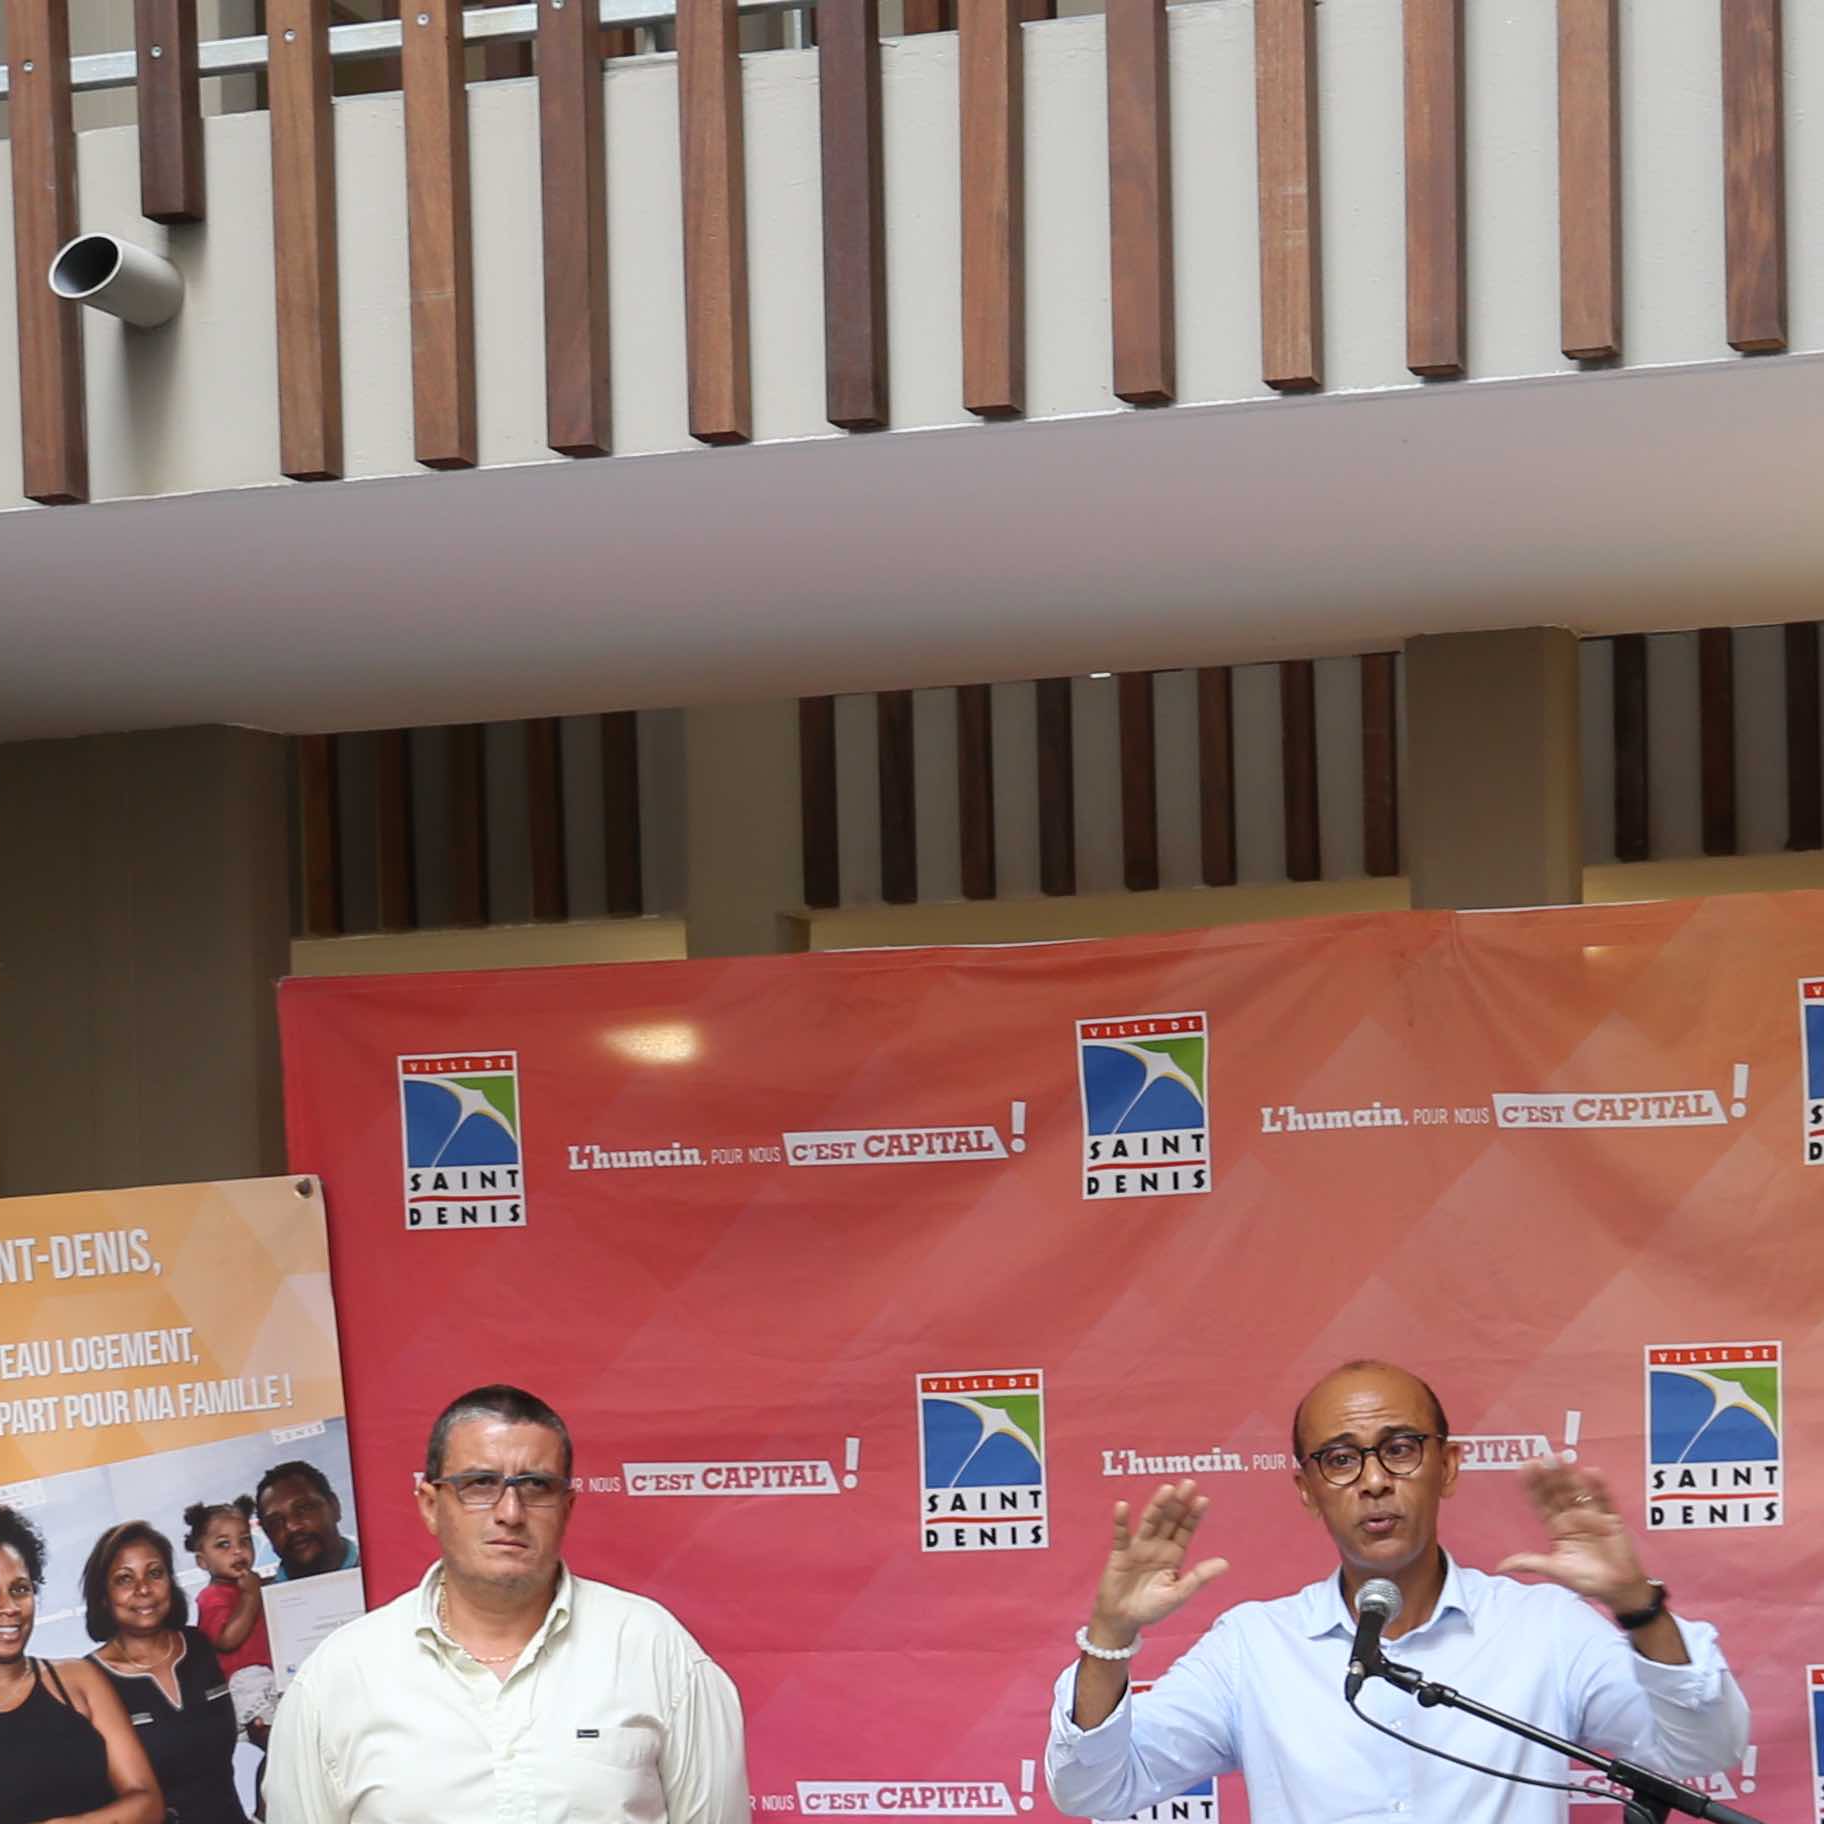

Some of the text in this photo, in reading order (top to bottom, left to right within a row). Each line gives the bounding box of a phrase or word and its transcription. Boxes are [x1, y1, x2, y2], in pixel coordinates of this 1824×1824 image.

[1089, 1020, 1196, 1037] VILLE DE
[410, 1058, 507, 1072] VILLE DE
[1501, 1104, 1565, 1124] C'EST
[1573, 1094, 1712, 1123] CAPITAL
[792, 1141, 856, 1162] C'EST
[863, 1129, 994, 1158] CAPITAL
[1089, 1134, 1205, 1160] SAINT
[409, 1169, 521, 1192] SAINT
[1088, 1169, 1205, 1195] DENIS
[409, 1203, 521, 1226] DENIS
[57, 1327, 200, 1374] LOGEMENT,
[1659, 1347, 1770, 1364] VILLE DE
[930, 1377, 1032, 1392] VILLE DE
[65, 1392, 131, 1431] POUR
[135, 1389, 176, 1424] MA
[178, 1377, 281, 1418] FAMILLE
[284, 1375, 293, 1408] !
[1252, 1454, 1286, 1471] POUR
[589, 1476, 621, 1493] NOUS
[632, 1474, 694, 1492] C'EST
[702, 1465, 826, 1490] CAPITAL
[1651, 1465, 1777, 1490] SAINT
[927, 1491, 1042, 1512] SAINT
[1650, 1503, 1777, 1525] DENIS
[927, 1525, 1042, 1548] DENIS
[762, 1796, 794, 1812] NOUS
[806, 1793, 869, 1810] C'EST
[877, 1786, 1003, 1810] CAPITAL
